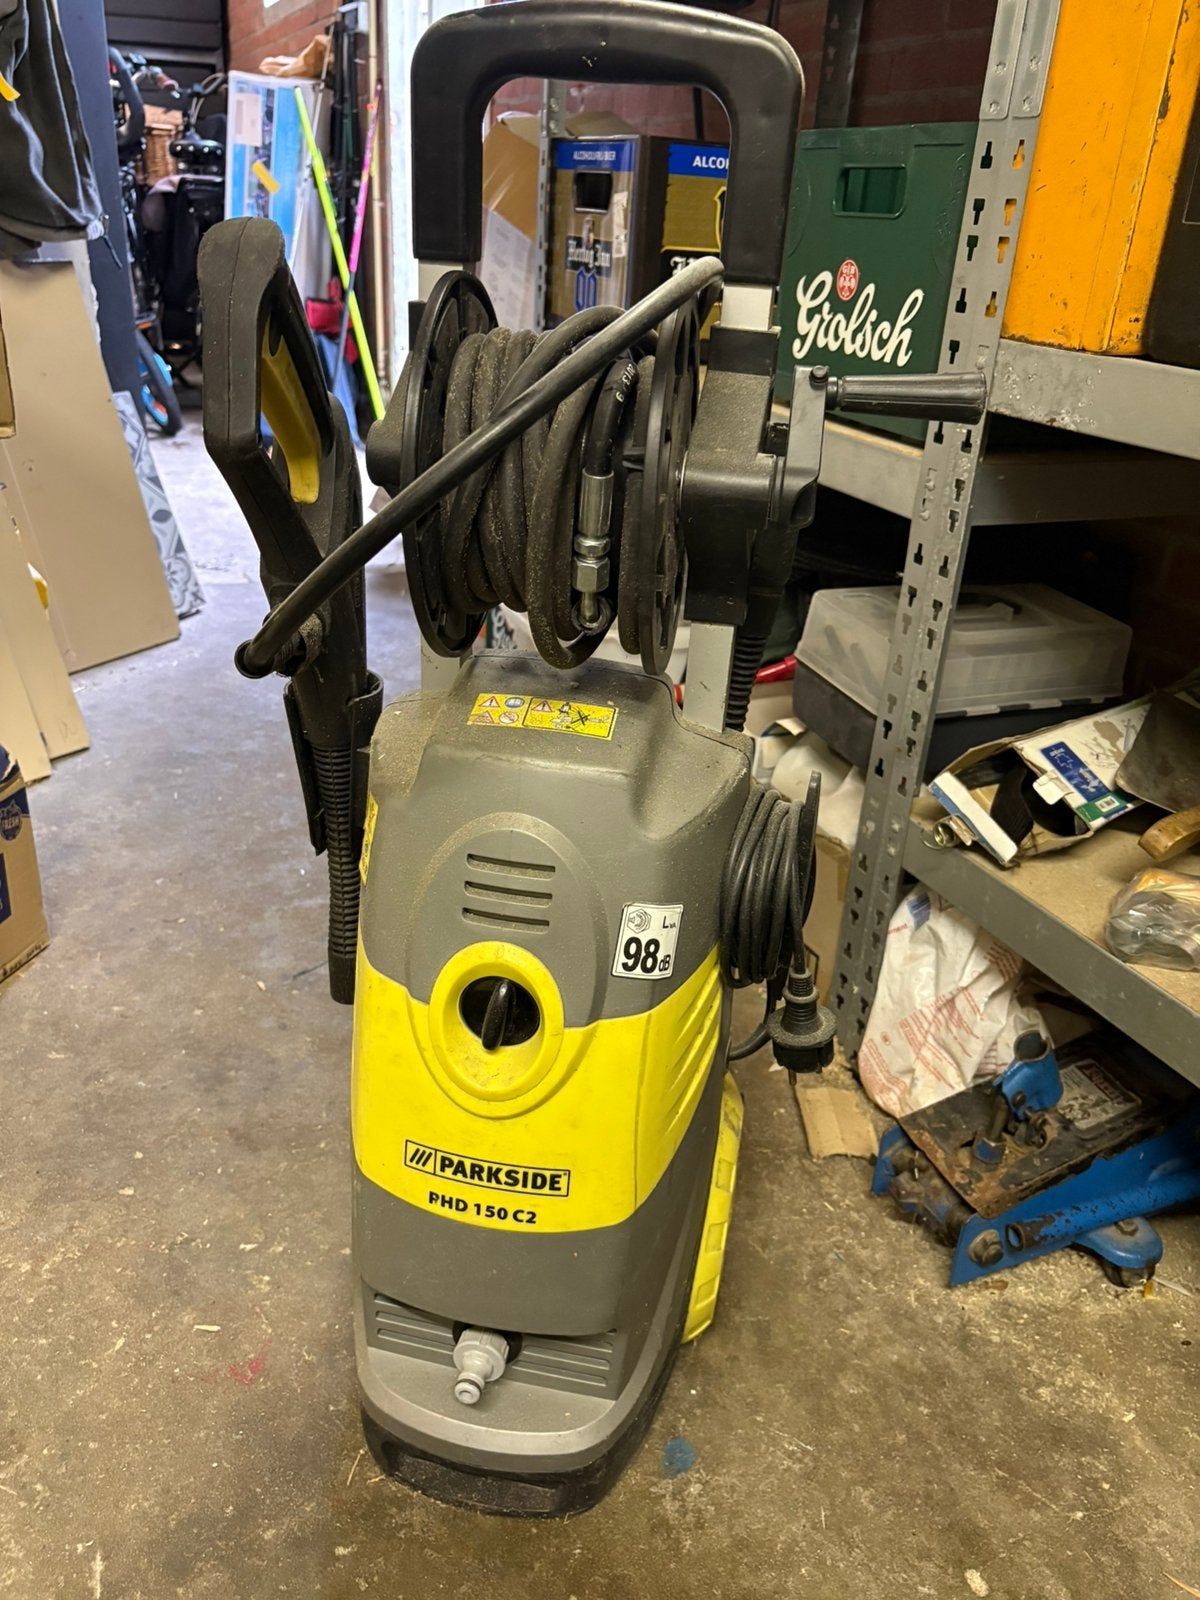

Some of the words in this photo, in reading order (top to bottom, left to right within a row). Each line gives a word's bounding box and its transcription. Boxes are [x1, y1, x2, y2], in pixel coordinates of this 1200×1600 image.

[792, 270, 925, 367] Grolsch
[621, 936, 660, 974] 98
[658, 954, 671, 972] dB
[439, 1155, 562, 1191] PARKSIDE
[473, 1203, 508, 1220] 150
[512, 1209, 537, 1224] C2
